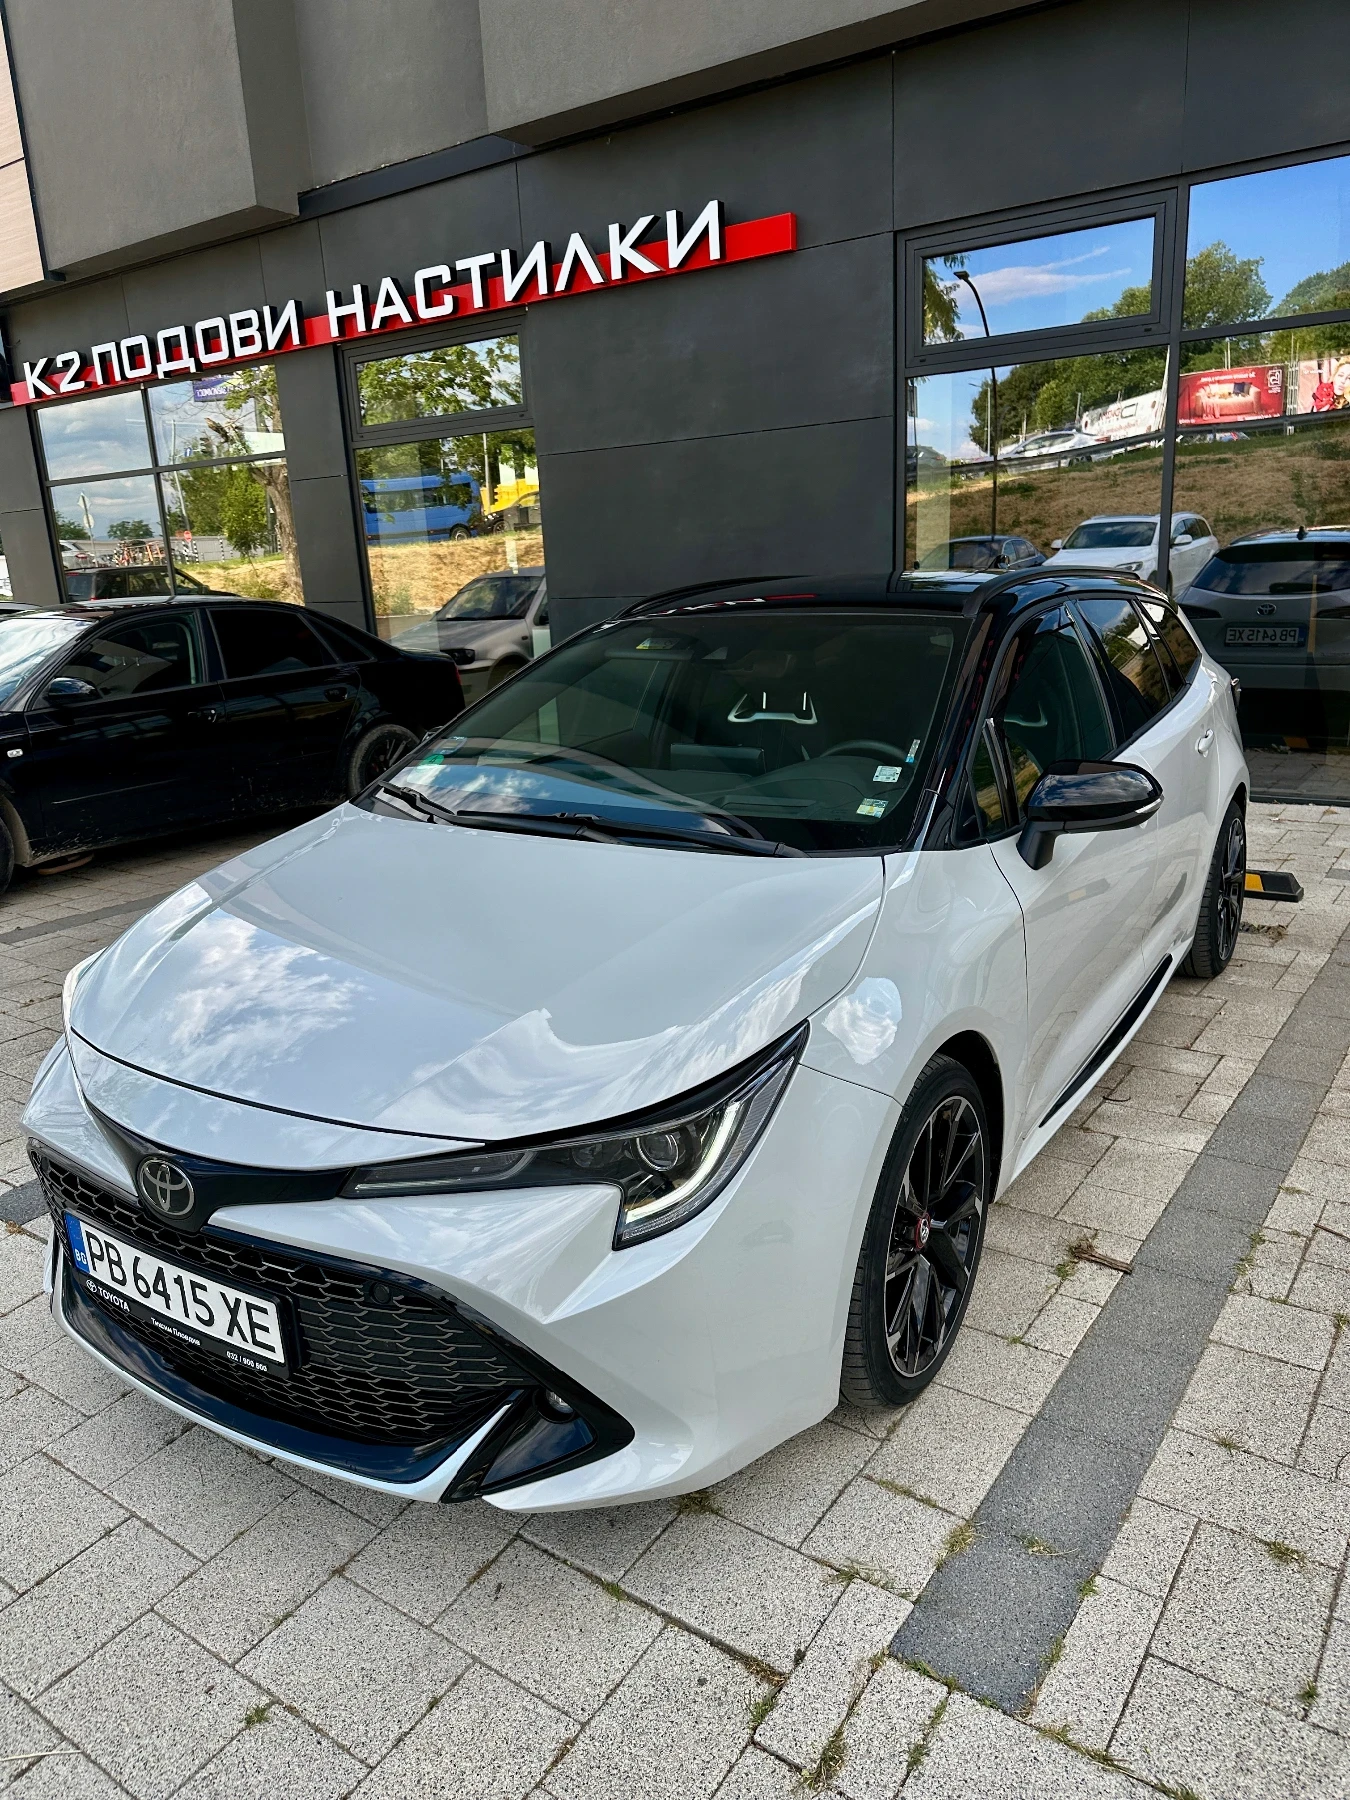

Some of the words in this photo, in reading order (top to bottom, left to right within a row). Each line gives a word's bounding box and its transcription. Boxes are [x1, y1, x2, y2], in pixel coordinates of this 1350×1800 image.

[91, 300, 300, 380] ПОДОВИ
[325, 199, 722, 338] НАСТИЛКИ
[74, 1249, 88, 1265] BG
[97, 1286, 131, 1312] TOYOTA
[132, 1255, 215, 1327] 6415
